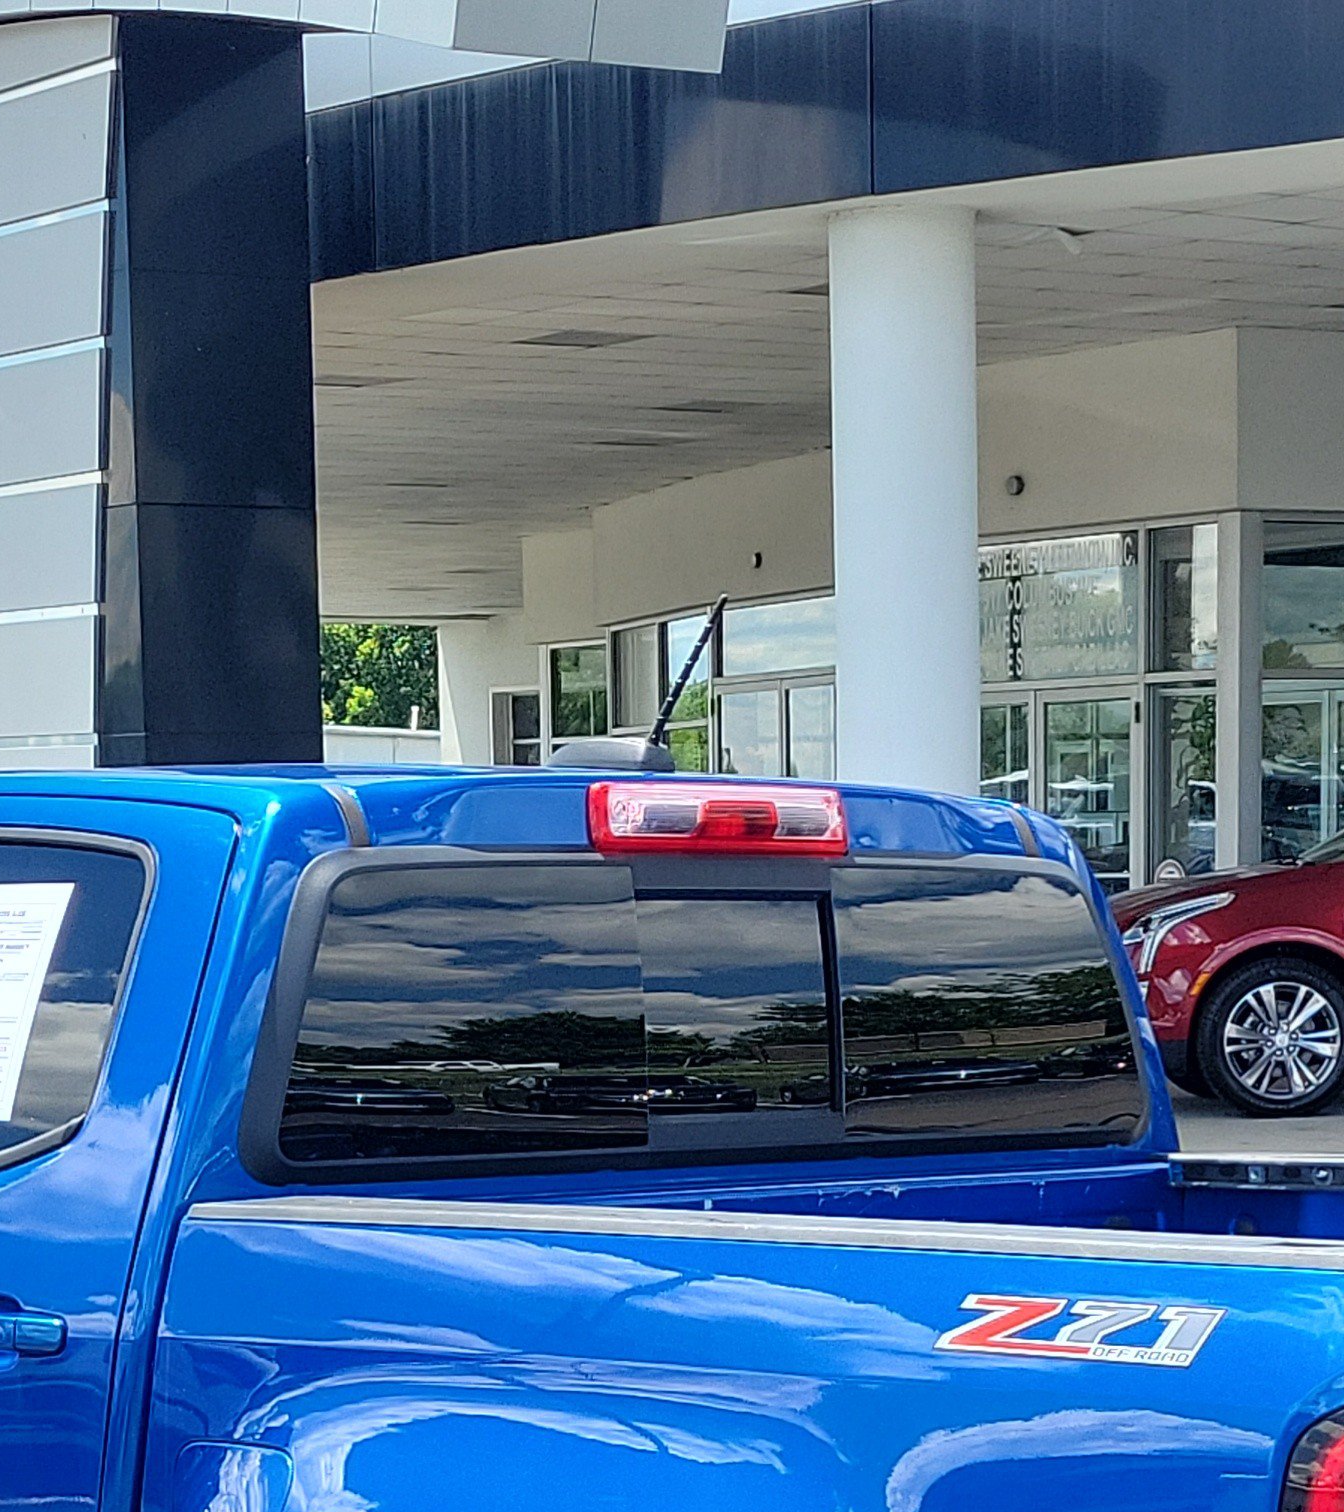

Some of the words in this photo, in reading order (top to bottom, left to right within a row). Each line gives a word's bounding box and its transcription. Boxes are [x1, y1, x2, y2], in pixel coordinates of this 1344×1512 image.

[933, 1293, 1227, 1362] Z71
[1092, 1347, 1131, 1359] OFF
[1134, 1349, 1190, 1363] ROAD
